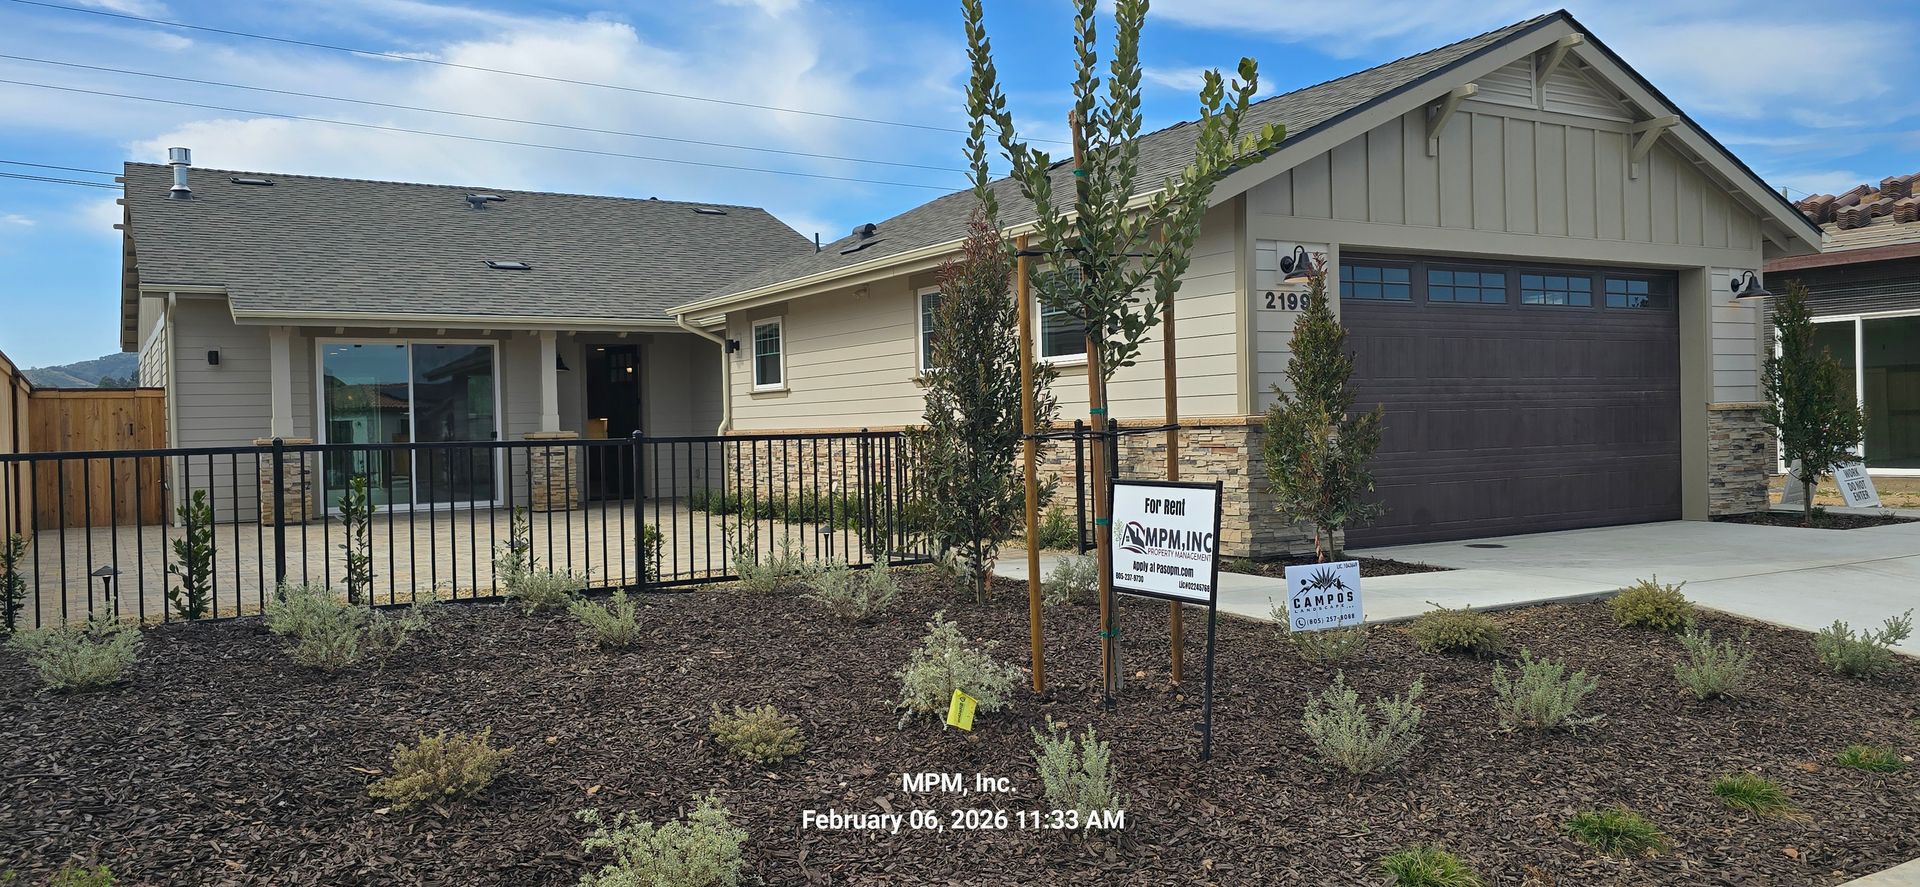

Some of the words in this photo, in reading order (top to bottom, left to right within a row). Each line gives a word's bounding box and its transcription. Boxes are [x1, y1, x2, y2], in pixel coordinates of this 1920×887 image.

[1265, 291, 1310, 310] 2199
[1843, 467, 1860, 478] WORK
[1847, 482, 1857, 492] DO
[1855, 480, 1867, 490] NOT
[1853, 490, 1870, 501] ENTER
[1145, 498, 1162, 514] For
[1164, 499, 1186, 516] Rent
[1145, 527, 1213, 553] MPM,INC
[1148, 548, 1175, 558] PROPERTY
[1175, 551, 1212, 562] MANAGEMENT
[1133, 560, 1148, 573] Apply
[1157, 563, 1194, 577] Pasopm.com
[1293, 591, 1354, 609] CAMPOS
[1295, 604, 1345, 613] LANDSCAPE
[1306, 617, 1324, 626] (805)
